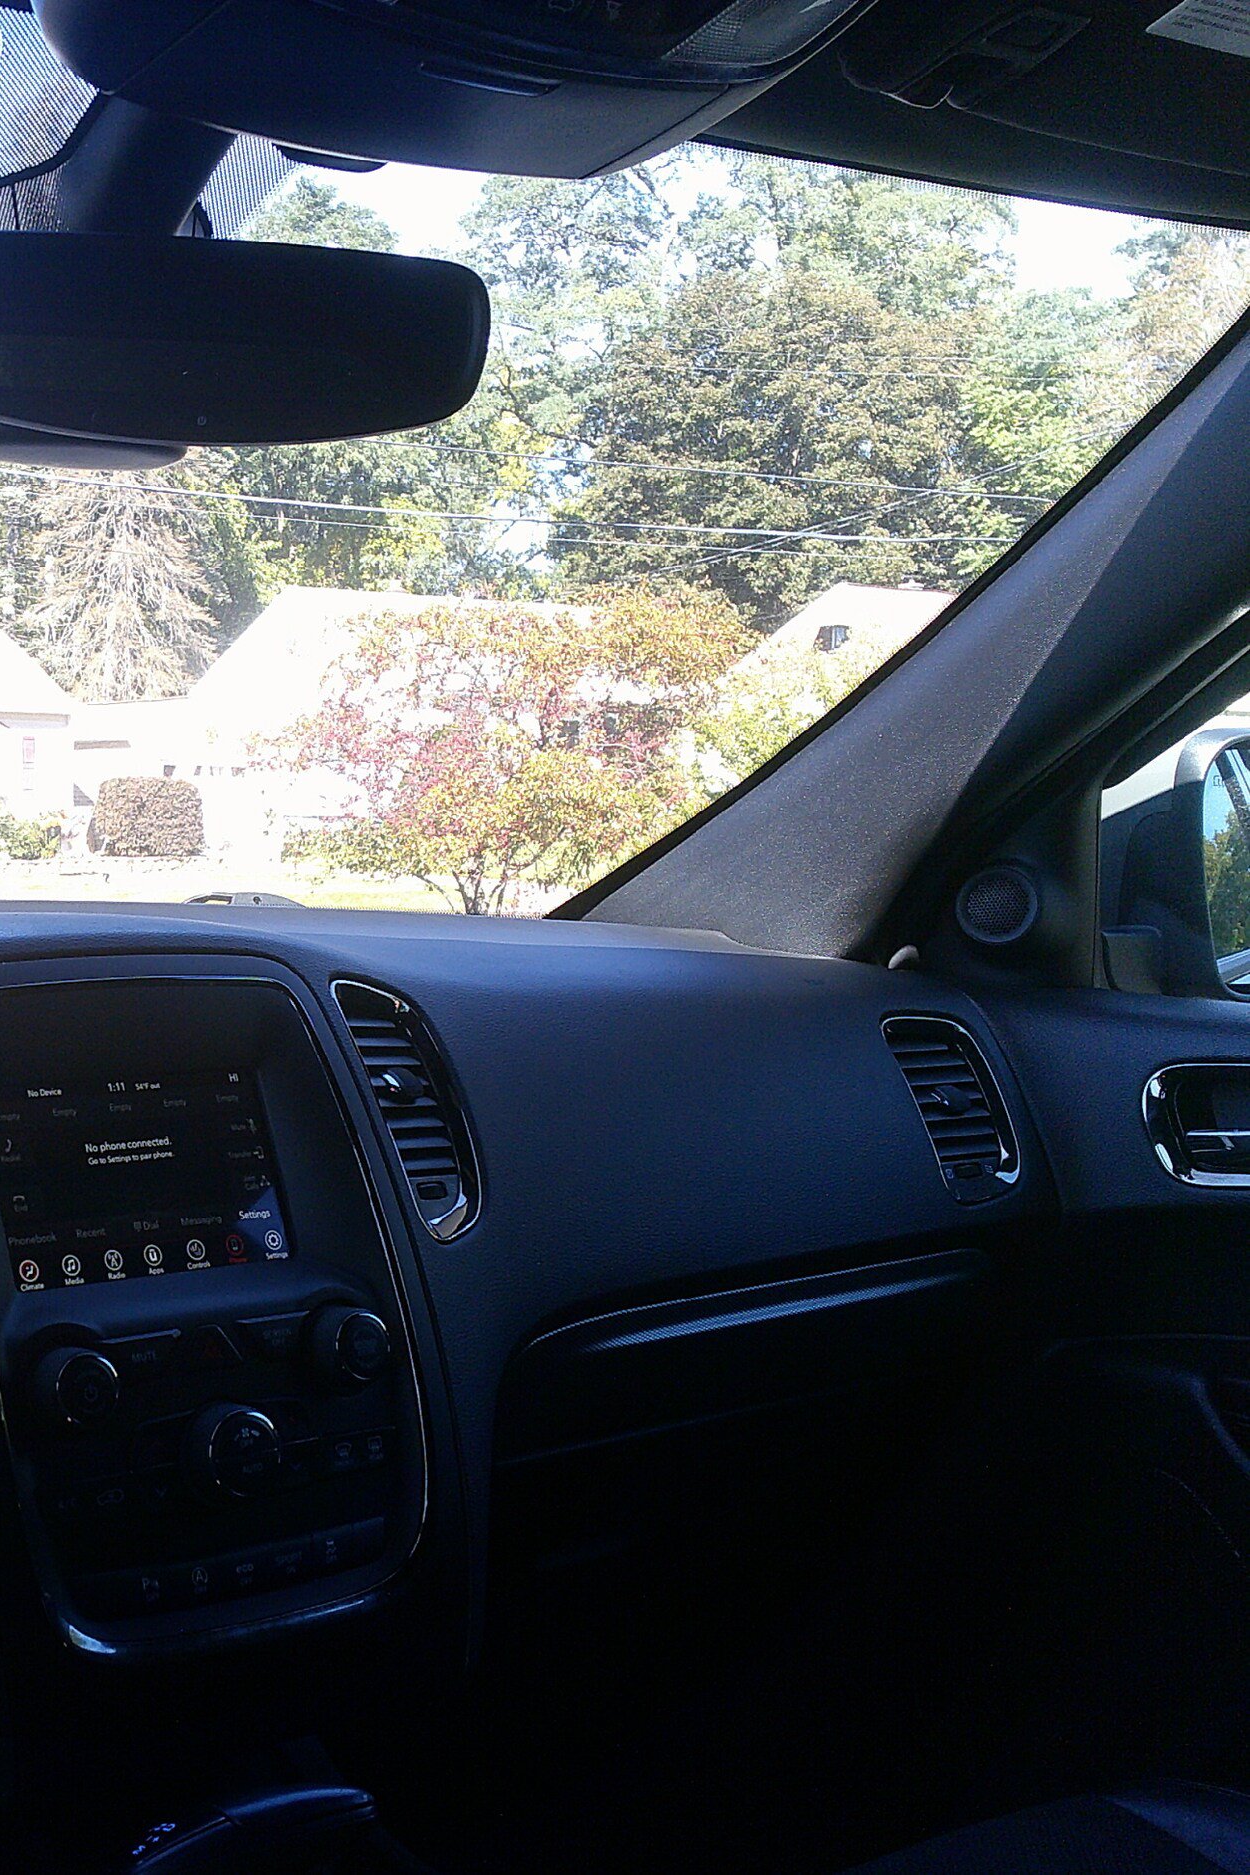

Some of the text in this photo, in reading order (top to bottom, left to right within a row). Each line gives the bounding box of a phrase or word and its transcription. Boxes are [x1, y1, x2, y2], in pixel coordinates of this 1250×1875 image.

[107, 1081, 126, 1092] 1:11
[27, 1087, 63, 1098] No Device
[84, 1136, 173, 1153] No phone connected.
[87, 1156, 99, 1166] Go
[99, 1156, 107, 1164] to
[107, 1153, 131, 1164] Settings
[131, 1153, 139, 1162] to
[139, 1152, 152, 1162] pair
[238, 1209, 271, 1221] Settings
[142, 1219, 160, 1231] Dial
[180, 1216, 223, 1227] Messaging
[75, 1227, 106, 1239] Recent
[7, 1232, 57, 1246] Phonebook
[265, 1251, 289, 1261] Settings
[186, 1259, 212, 1270] Controls
[107, 1271, 127, 1280] Radio
[148, 1266, 165, 1276] Apps
[64, 1276, 85, 1286] Media
